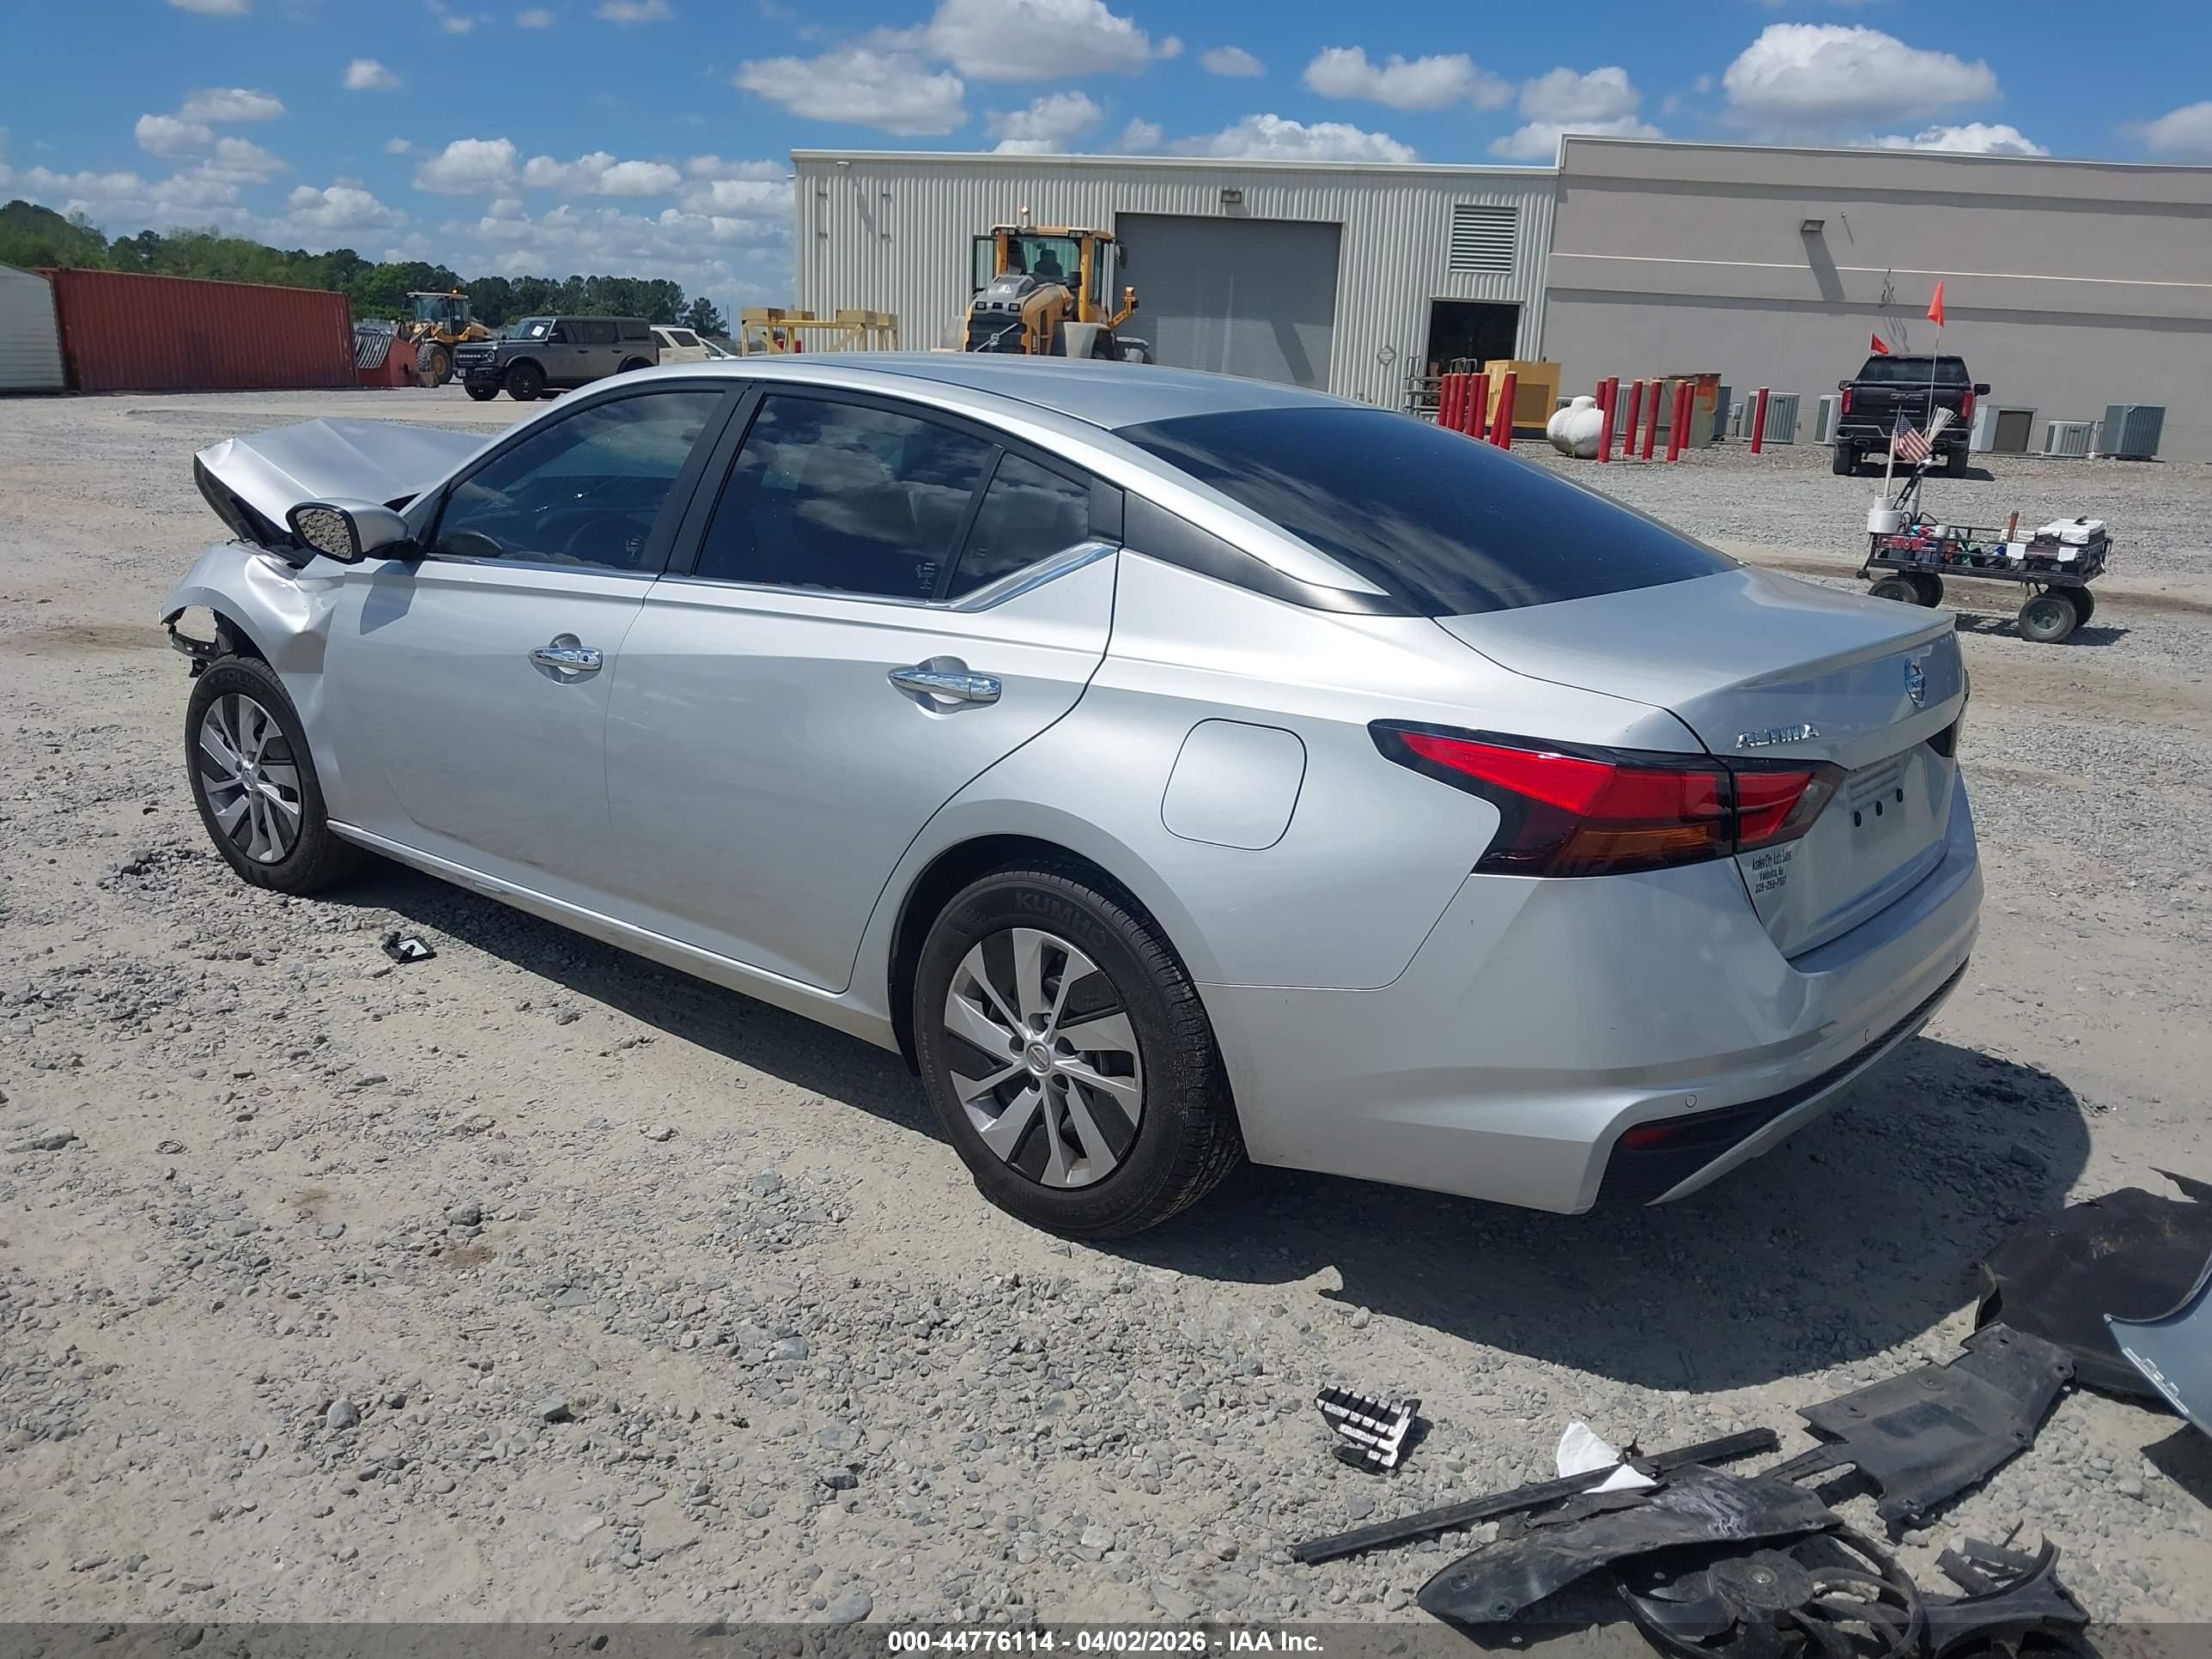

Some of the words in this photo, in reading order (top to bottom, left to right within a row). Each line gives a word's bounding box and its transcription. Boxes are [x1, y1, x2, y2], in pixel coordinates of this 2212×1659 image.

[1890, 392, 1924, 401] GMC
[1735, 722, 1820, 749] ALTIMA
[1016, 892, 1108, 947] KUMHO
